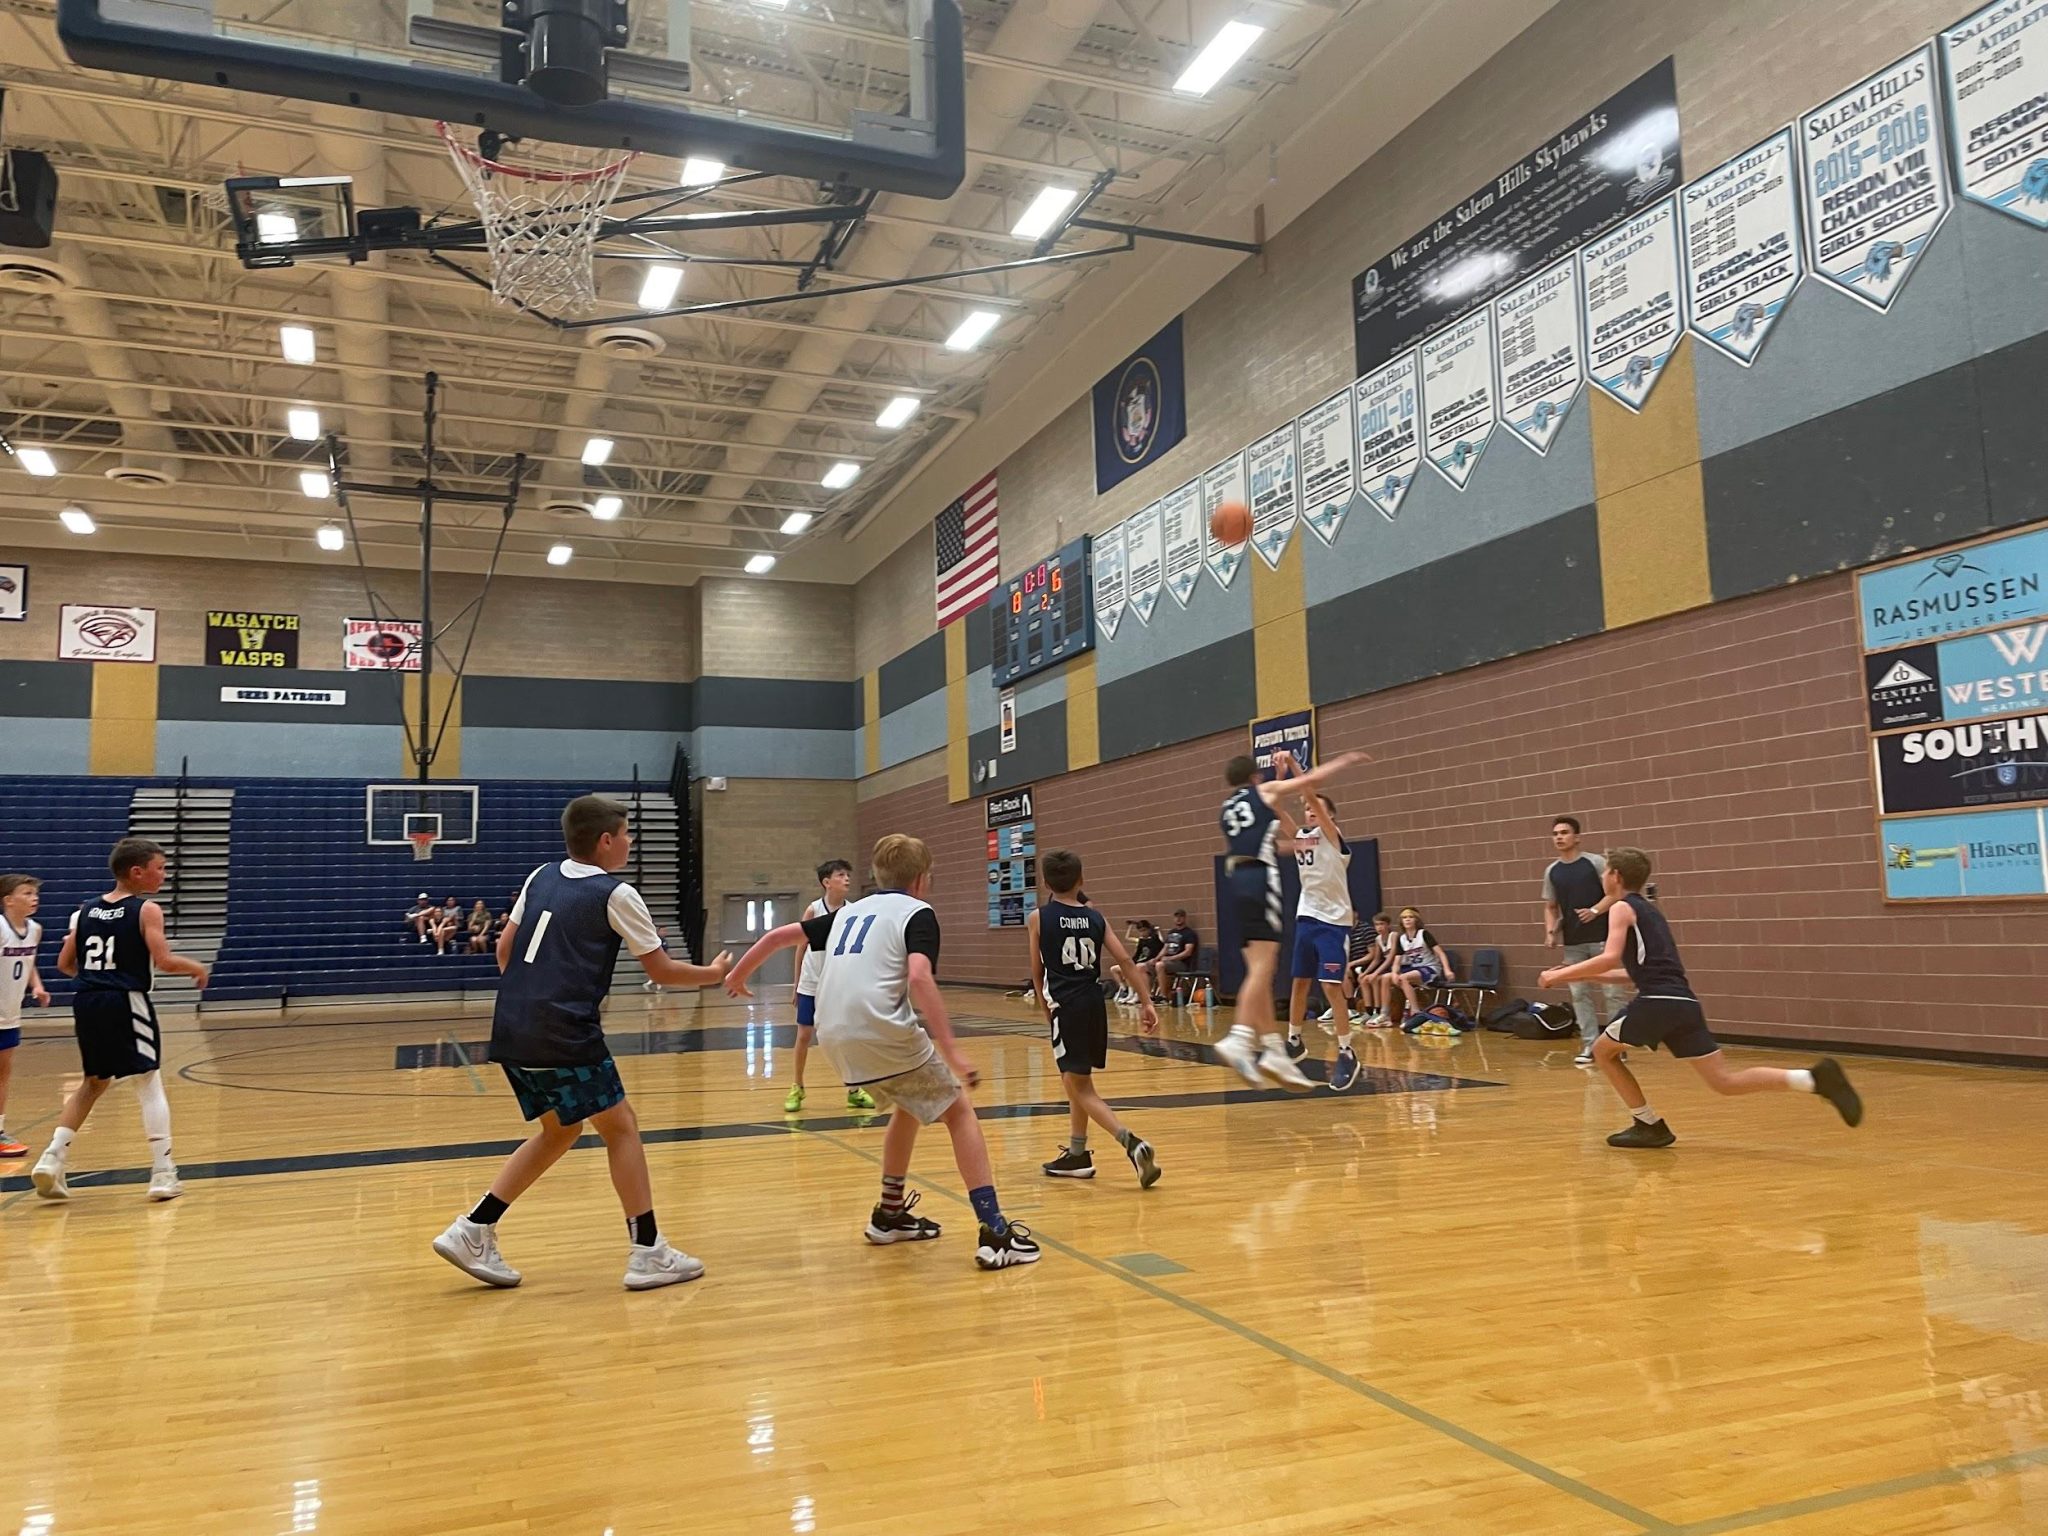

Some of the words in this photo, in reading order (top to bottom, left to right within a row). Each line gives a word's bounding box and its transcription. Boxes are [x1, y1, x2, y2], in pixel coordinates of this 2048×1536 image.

[1808, 96, 1867, 140] SALEM
[1869, 63, 1925, 108] HILLS
[1832, 99, 1904, 148] ATHLETICS
[1815, 104, 1928, 198] 2015-2016
[1984, 138, 2033, 171] BOYS
[1391, 248, 1408, 270] We
[1412, 237, 1430, 258] are
[1433, 221, 1452, 242] the
[1456, 192, 1494, 227] Salem
[1497, 164, 1531, 198] Hills
[1535, 113, 1608, 172] Skyhawks
[1686, 170, 1736, 204] SALEM
[1738, 142, 1785, 176] HILLS
[1705, 168, 1768, 211] ATHLETICS
[1823, 168, 1886, 215] REGION
[1894, 148, 1926, 177] VIII
[1821, 167, 1931, 234] CHAMPIONS
[1585, 233, 1627, 262] SALEM
[1629, 209, 1670, 239] HILLS
[1820, 226, 1866, 257] GIRLS
[1872, 192, 1935, 233] SOCCER
[1601, 233, 1654, 270] ATHLETICS
[1696, 241, 1789, 293] CHAMPIONS
[1698, 249, 1753, 282] REGION
[1759, 232, 1786, 250] VIII
[1500, 288, 1535, 317] SALEM
[1537, 268, 1571, 295] HILLS
[1700, 286, 1738, 313] GIRLS
[1743, 263, 1789, 292] TRACK
[1424, 333, 1455, 357] SALEM
[1457, 317, 1486, 340] HILLS
[1594, 300, 1672, 345] CHAMPIONS
[1596, 305, 1642, 335] REGION
[1598, 342, 1627, 363] BOYS
[1632, 321, 1670, 345] TRACK
[1359, 377, 1385, 401] SALEM
[1386, 361, 1413, 385] HILLS
[1506, 354, 1573, 392] CHAMPIONS
[1507, 358, 1547, 383] REGION
[1515, 374, 1564, 404] BASEBALL
[1430, 395, 1488, 429] CHAMPIONS
[1431, 398, 1464, 421] REGION
[1364, 428, 1394, 452] REGION
[1364, 430, 1414, 465] CHAMPIONS
[1439, 417, 1480, 441] SOFTBALL
[1873, 573, 2039, 627] RASMUSSEN
[207, 612, 299, 630] WASATCH
[1903, 611, 2010, 640] JEWELERS
[220, 650, 286, 667] WASPS
[274, 691, 331, 701] PATRONS
[1872, 684, 1937, 701] CENTRAL
[1886, 697, 1921, 707] BANK
[1981, 699, 2039, 713] HEATING
[1903, 715, 2048, 764] SOUTH
[1223, 801, 1256, 836] 33
[1296, 849, 1314, 866] 33
[523, 909, 553, 964] 1
[833, 914, 877, 956] 11
[1060, 917, 1089, 929] COWAN
[13, 960, 23, 980] 0
[84, 935, 117, 970] 21
[1061, 937, 1097, 971] 40
